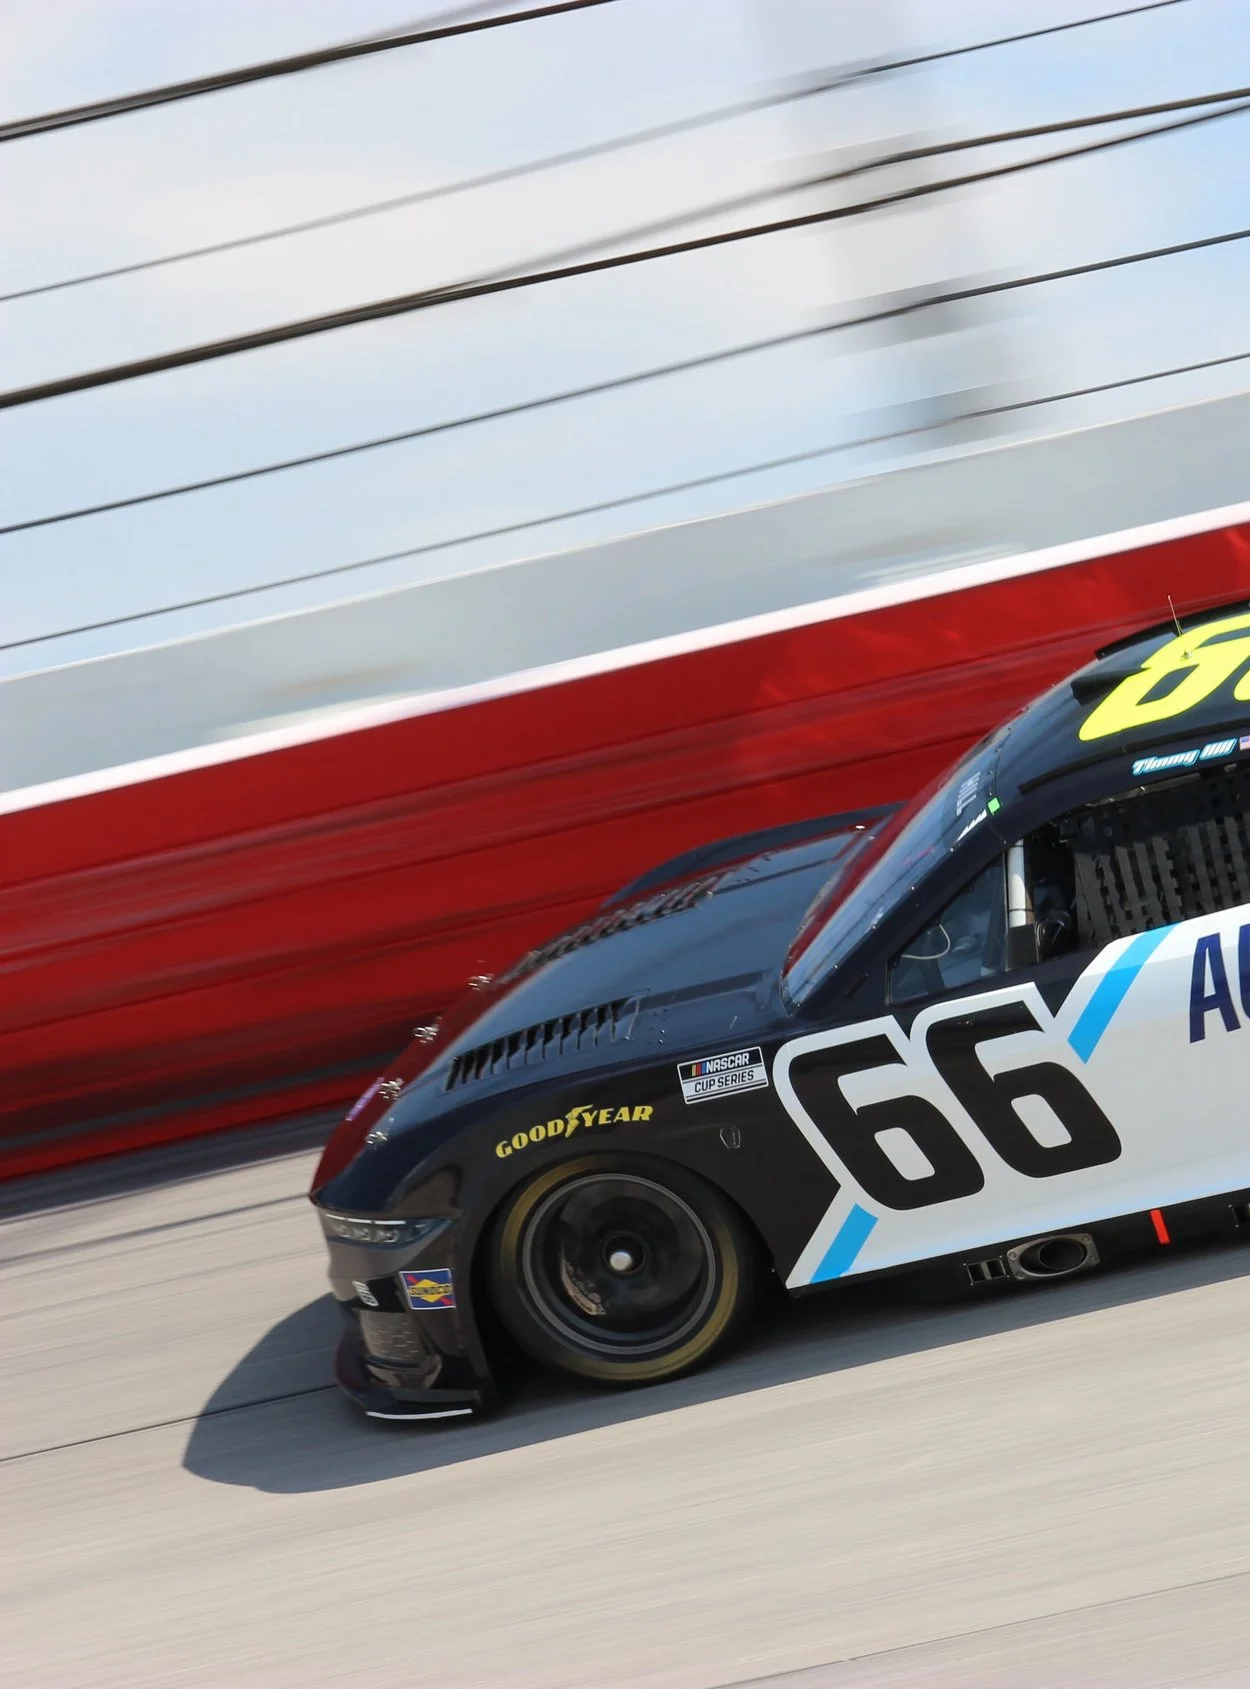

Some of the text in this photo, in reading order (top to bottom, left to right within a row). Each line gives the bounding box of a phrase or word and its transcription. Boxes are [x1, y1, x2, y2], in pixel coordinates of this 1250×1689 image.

[694, 1069, 754, 1093] CUP SERIES
[706, 1052, 750, 1074] NASCAR
[788, 1000, 1123, 1211] 66
[495, 1104, 654, 1158] GOODYEAR
